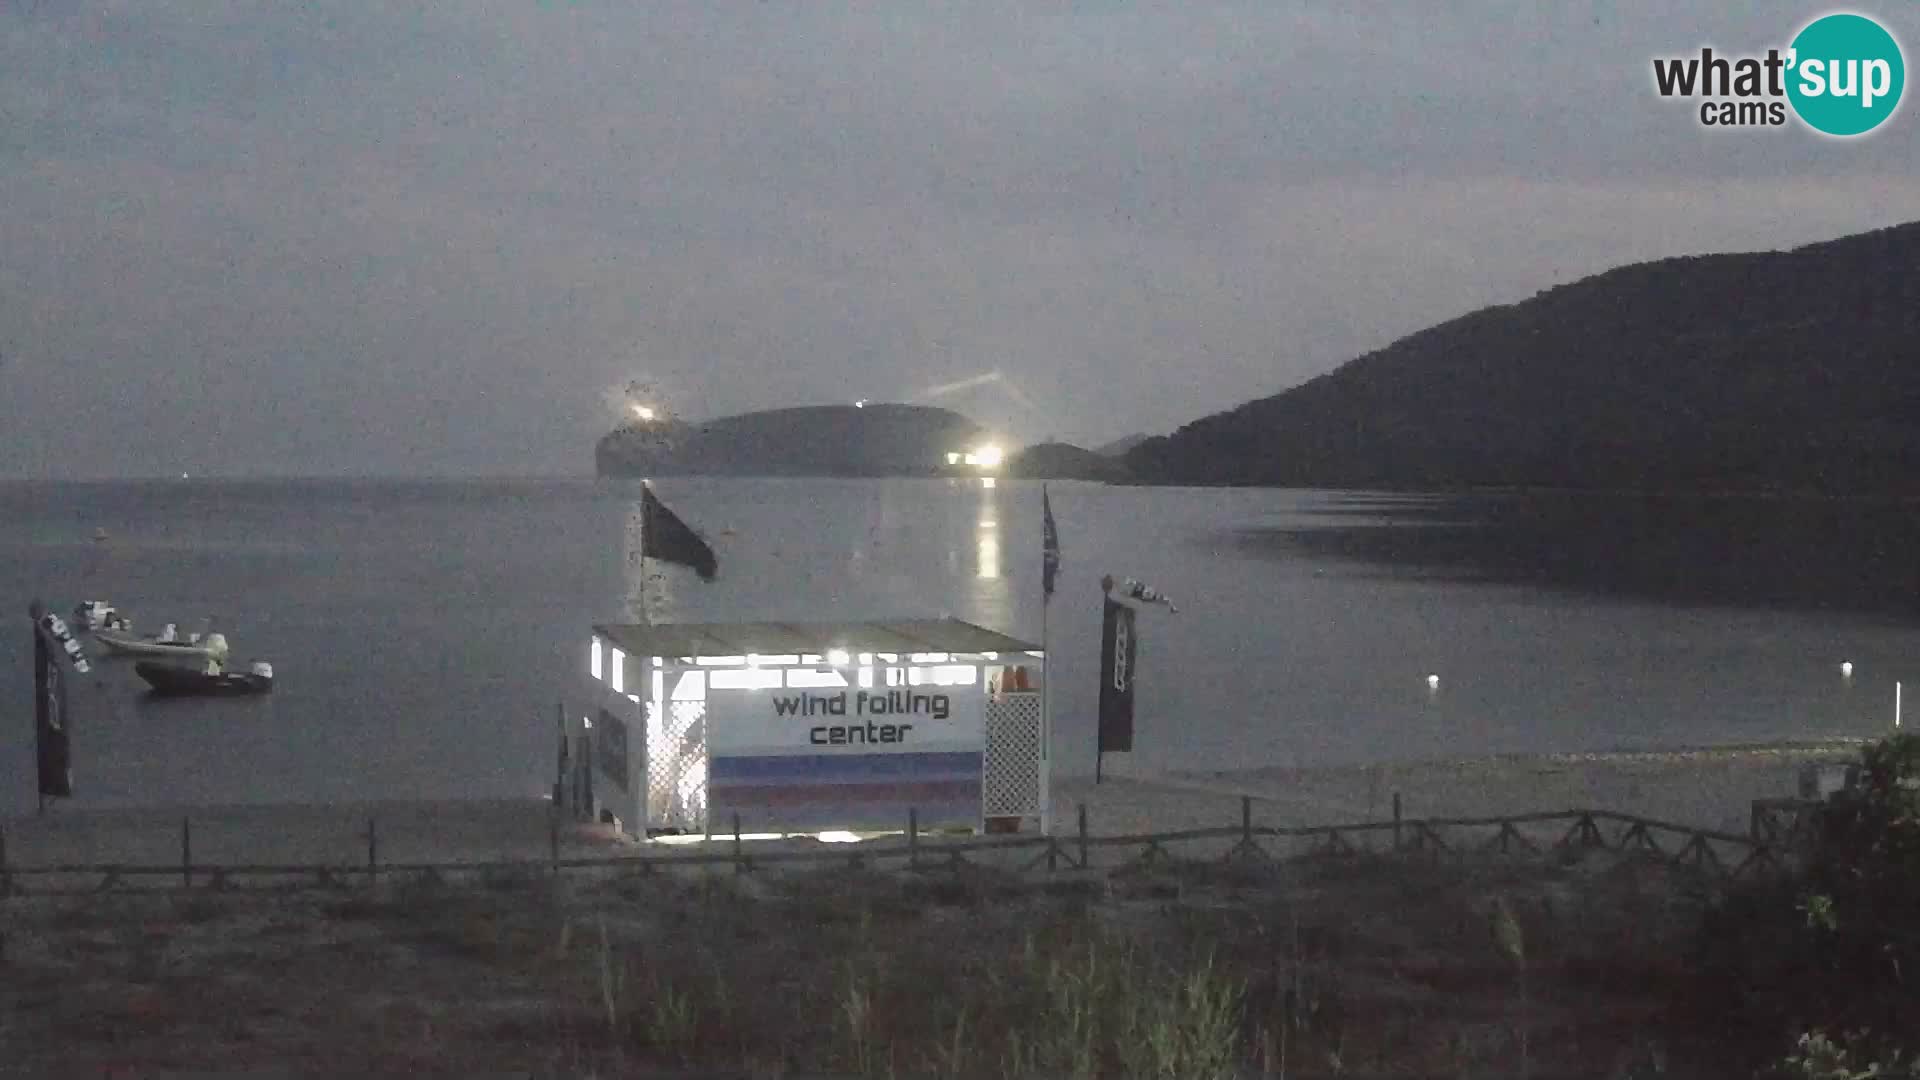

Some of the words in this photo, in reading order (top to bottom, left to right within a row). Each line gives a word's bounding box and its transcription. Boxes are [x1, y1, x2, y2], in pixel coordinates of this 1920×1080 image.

[773, 690, 846, 717] wind
[856, 690, 950, 720] foiling
[809, 720, 913, 745] center
